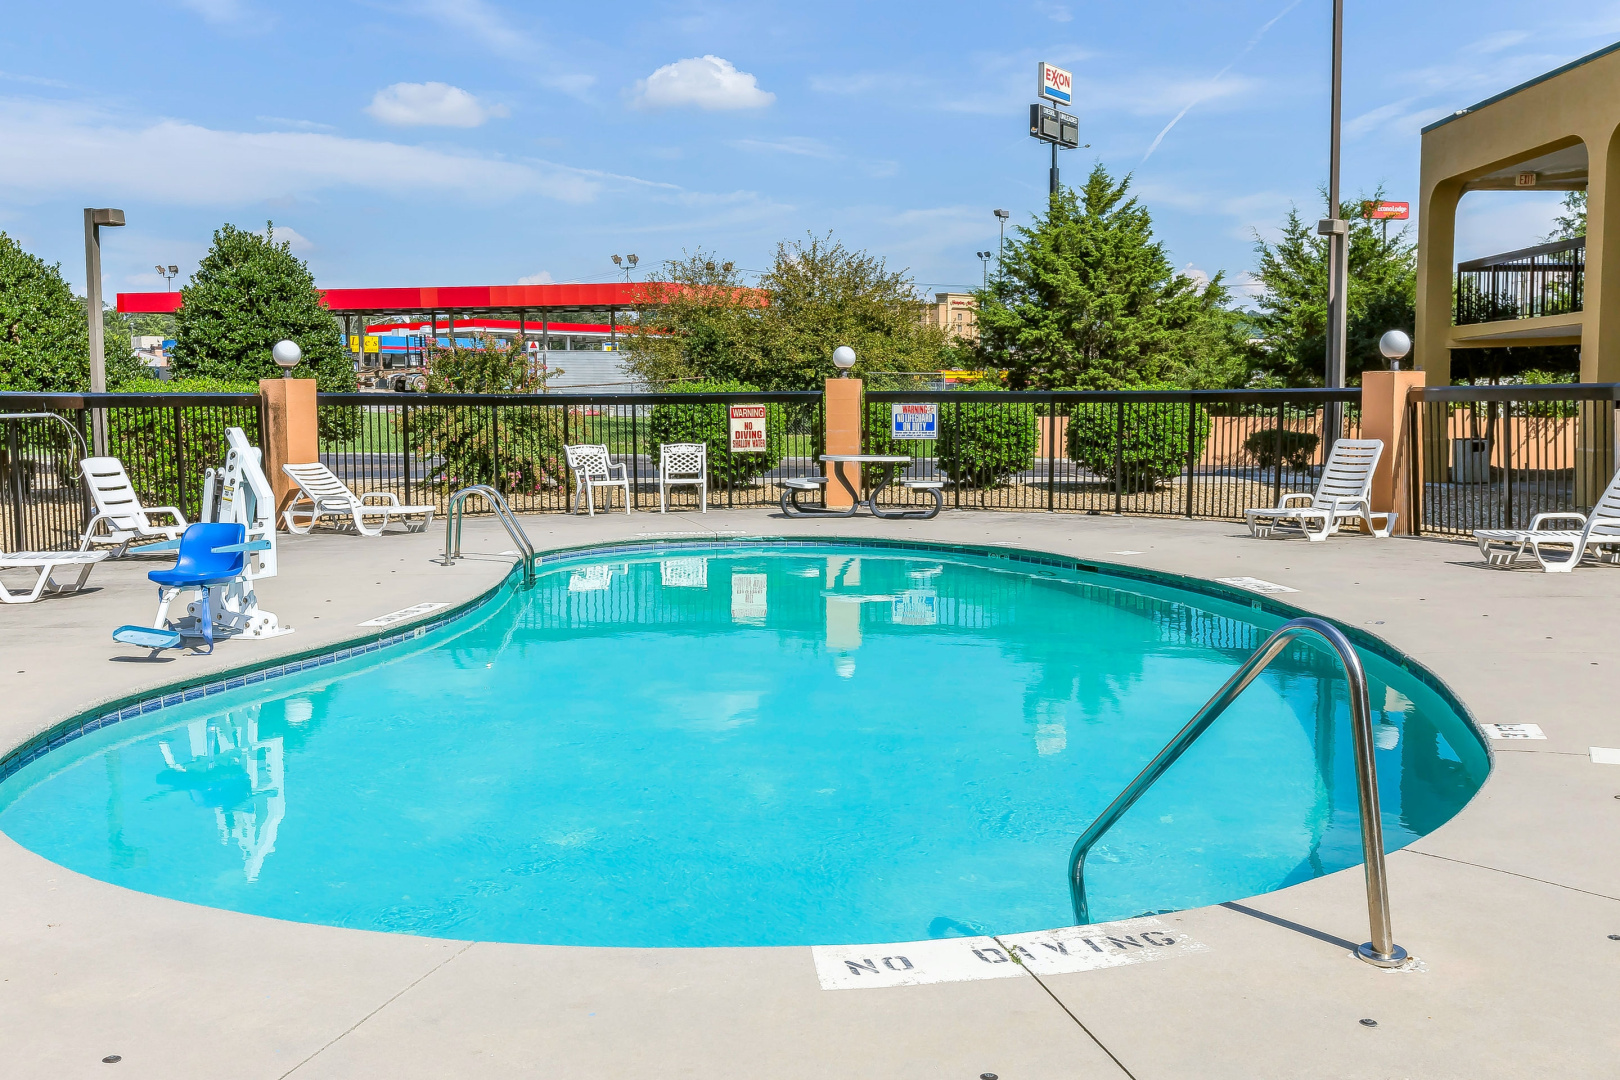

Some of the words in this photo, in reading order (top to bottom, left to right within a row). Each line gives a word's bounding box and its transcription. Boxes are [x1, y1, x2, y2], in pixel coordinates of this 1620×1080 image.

[1045, 67, 1070, 90] EXXON
[1520, 174, 1533, 185] EXIT
[732, 408, 764, 418] WARNING
[902, 405, 928, 414] WARNING
[896, 413, 905, 423] NO
[744, 421, 753, 431] NO
[902, 422, 911, 431] ON
[912, 422, 927, 431] DUTY
[735, 430, 763, 440] DIVING
[843, 955, 915, 976] NO
[971, 931, 1176, 964] DIVING
